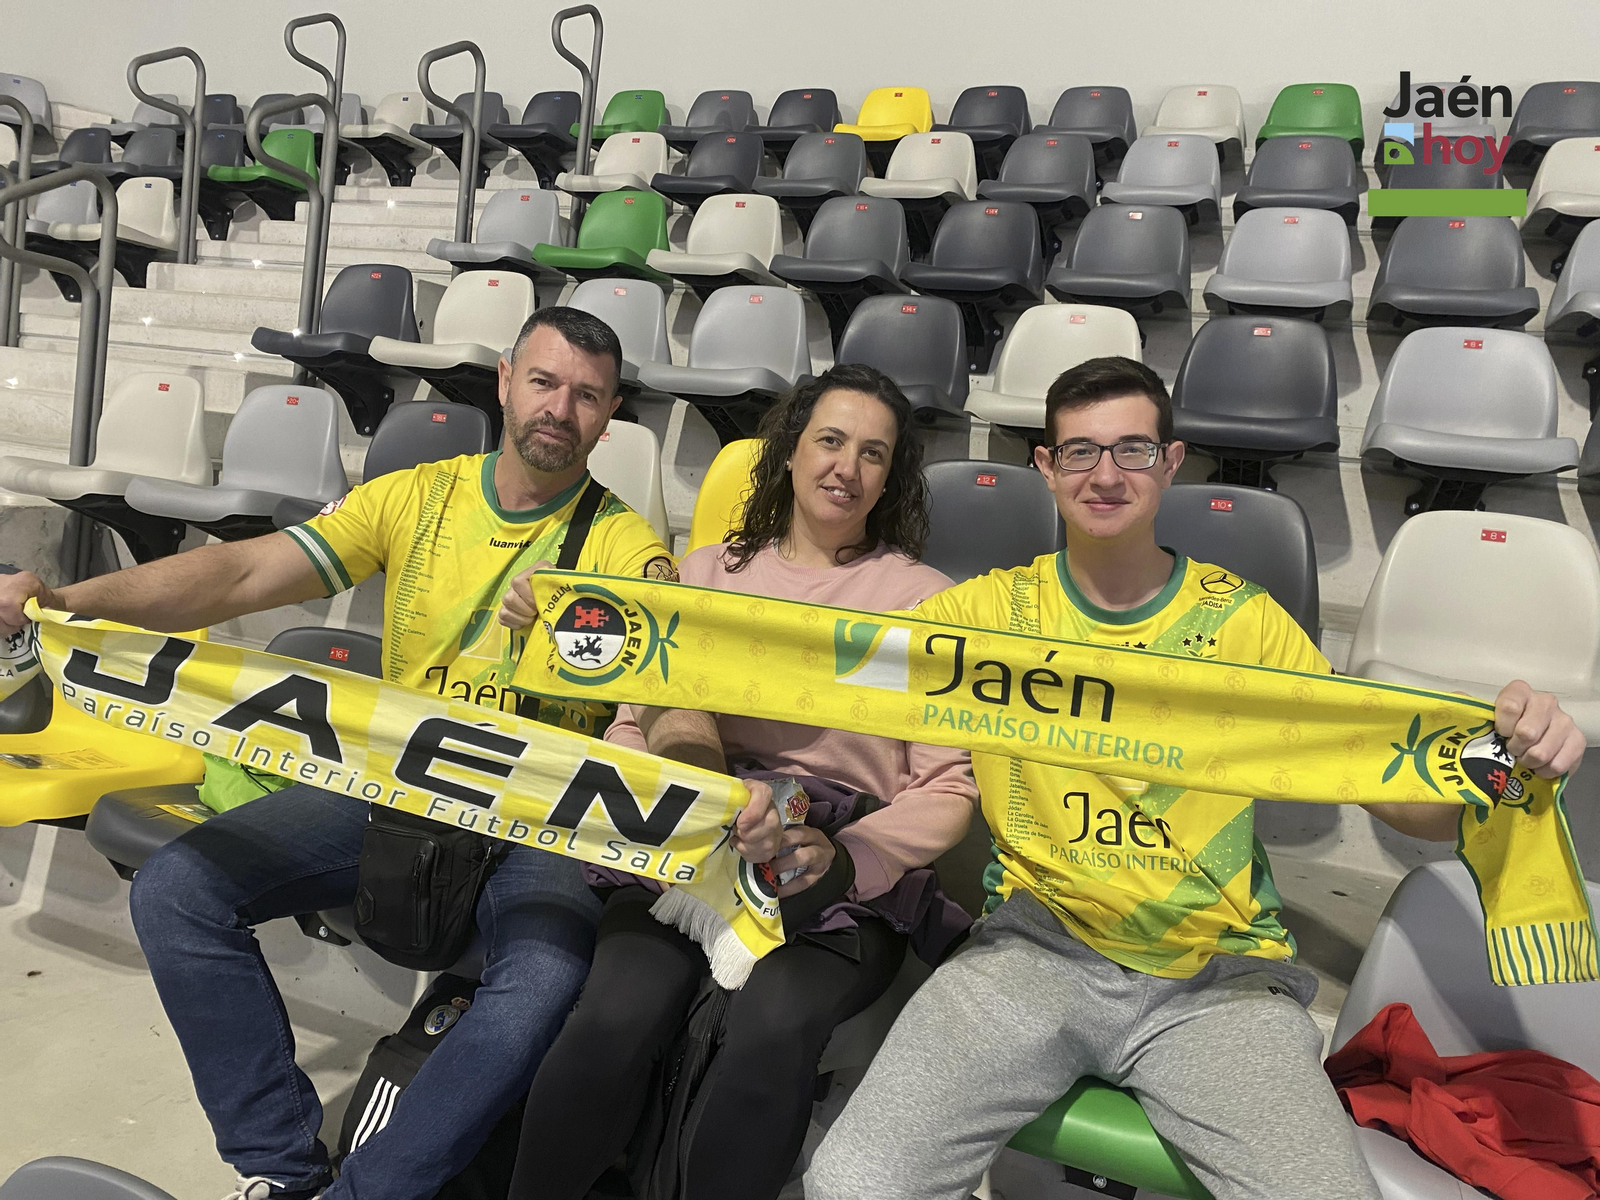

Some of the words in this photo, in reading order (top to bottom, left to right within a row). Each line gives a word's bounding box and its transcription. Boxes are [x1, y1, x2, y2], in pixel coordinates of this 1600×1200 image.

[621, 608, 642, 667] JAEN
[924, 633, 1115, 723] Jaén
[923, 703, 1040, 743] PARAÍSO
[1047, 725, 1185, 771] INTERIOR
[1438, 732, 1469, 786] JAEN
[62, 682, 212, 748] Paraíso
[233, 737, 406, 806] Interior
[426, 796, 577, 851] Fútbol
[601, 840, 697, 881] Sala
[1050, 843, 1121, 869] PARAÍSO
[1126, 854, 1201, 875] INTERIO
